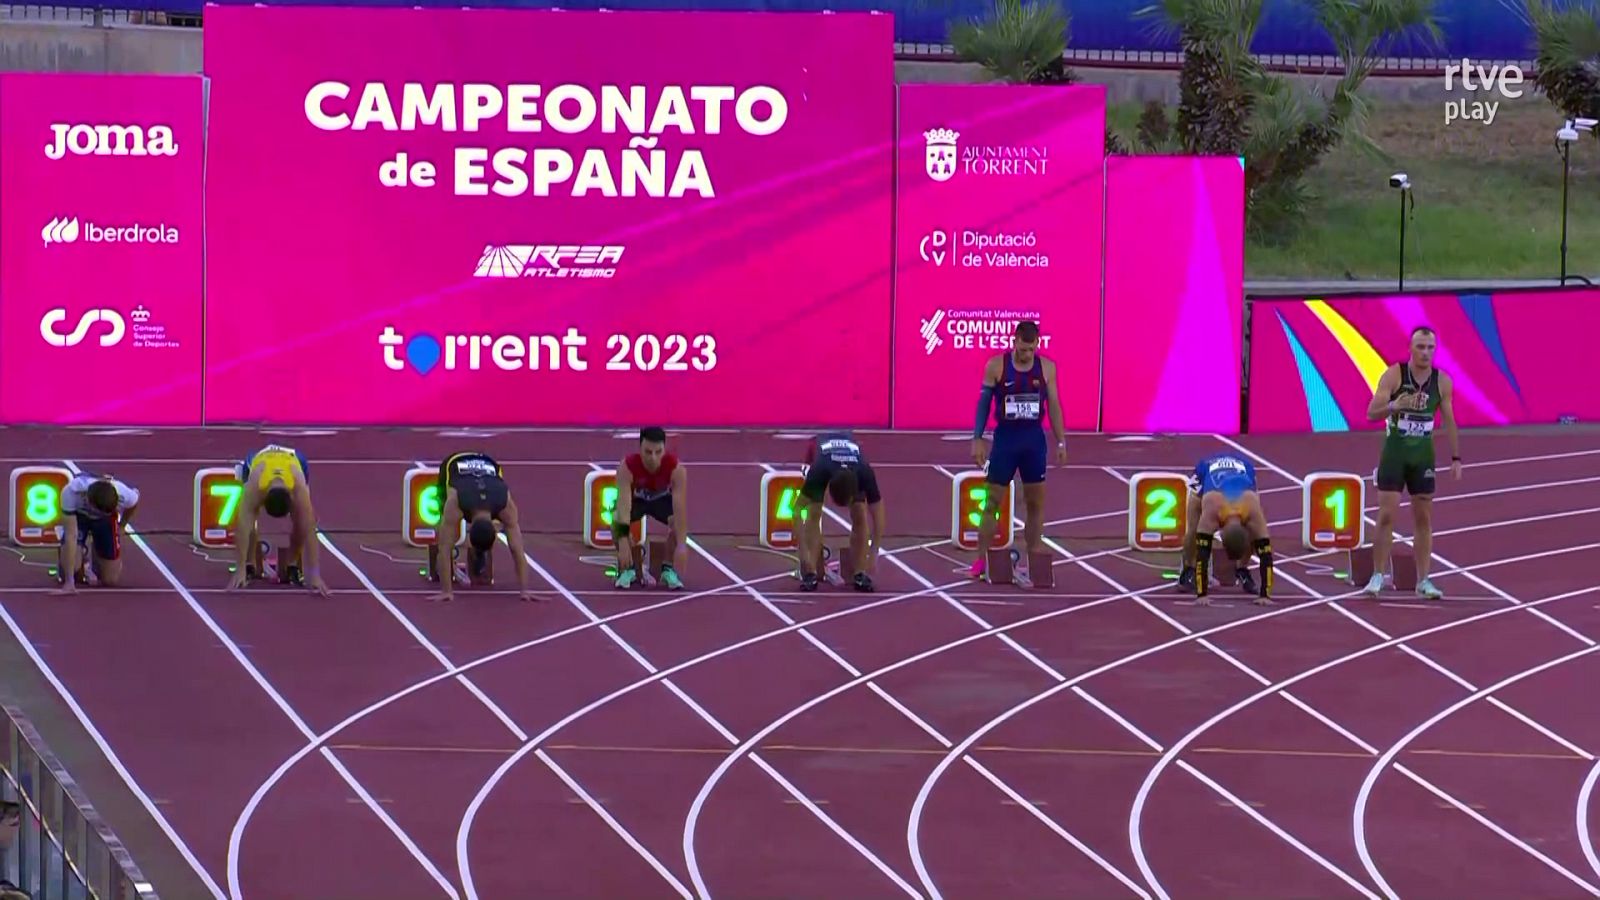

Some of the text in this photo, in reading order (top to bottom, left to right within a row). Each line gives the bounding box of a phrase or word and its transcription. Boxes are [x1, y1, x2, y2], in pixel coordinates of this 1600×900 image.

[304, 81, 788, 135] CAMPEONATO
[45, 124, 178, 159] Joma
[379, 136, 715, 198] de ESPAÑA
[962, 159, 1048, 175] TORRENT
[84, 223, 178, 243] Iberdrola
[963, 231, 1036, 249] Diputació
[523, 267, 616, 278] ATLETISMO
[529, 246, 625, 269] RFEA
[962, 252, 1049, 267] de València
[947, 309, 1040, 318] Comunitat Valenciana
[605, 334, 717, 371] 2023
[953, 334, 974, 349] DE
[27, 484, 57, 524] 8
[210, 485, 242, 525] 7
[418, 486, 441, 526] 6
[1146, 489, 1177, 529] 2
[1325, 489, 1345, 529] 1
